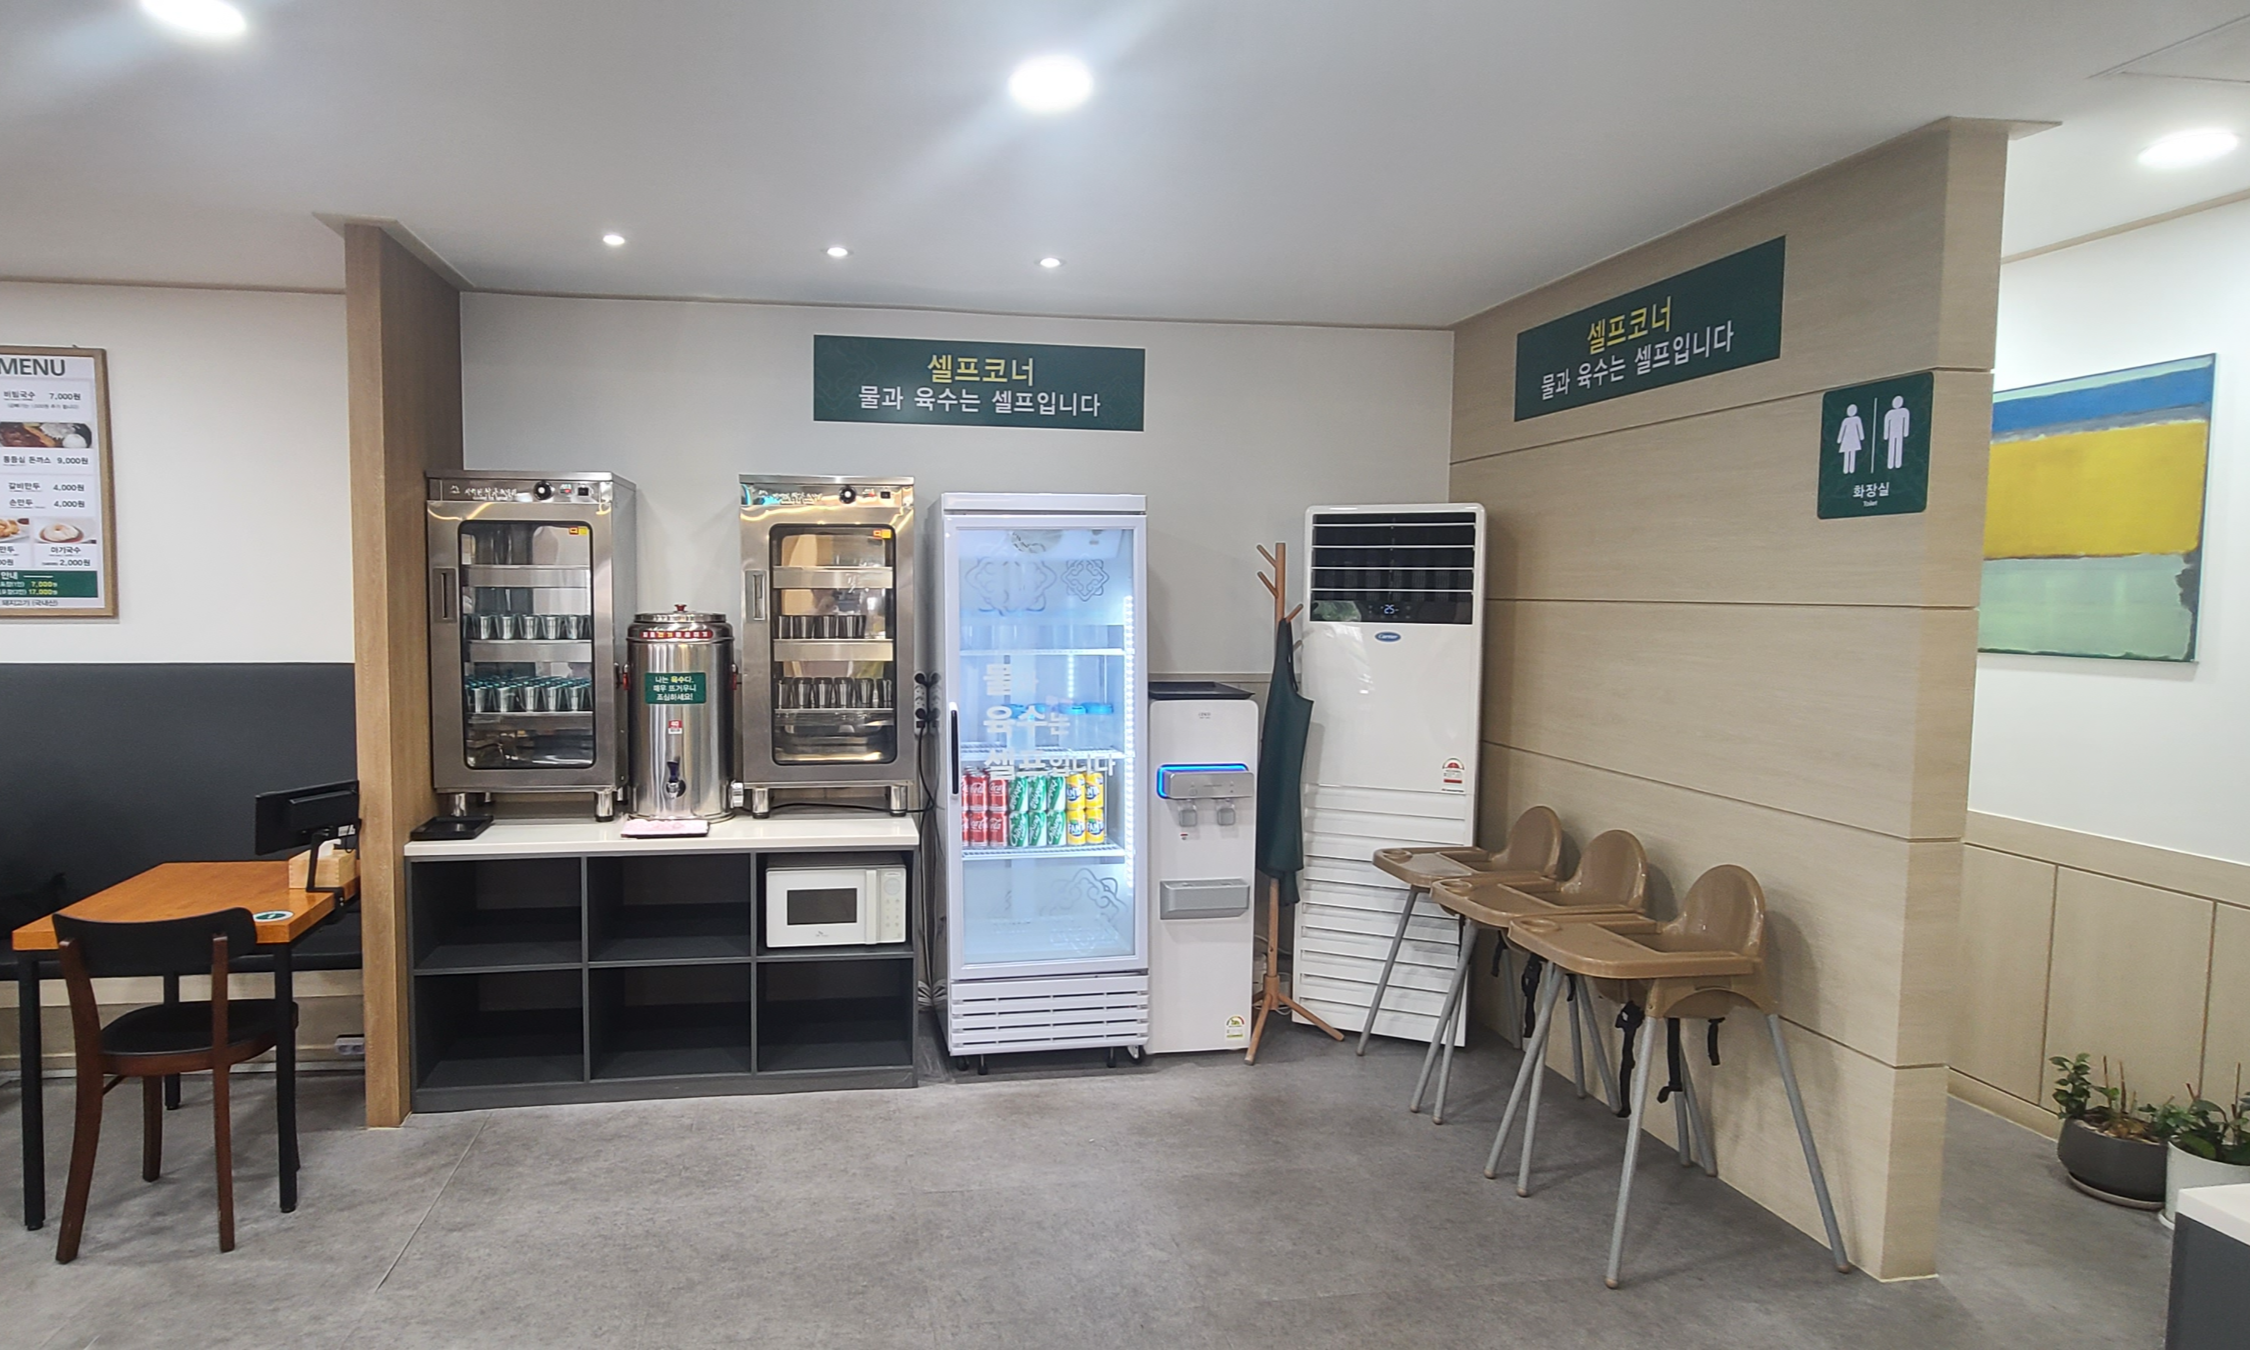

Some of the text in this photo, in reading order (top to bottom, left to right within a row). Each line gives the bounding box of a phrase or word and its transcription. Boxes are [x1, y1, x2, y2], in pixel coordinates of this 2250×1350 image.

[1586, 296, 1672, 355] 셀프코너
[0, 357, 65, 376] MENU
[927, 353, 1035, 387] 셀프코너
[1541, 320, 1734, 401] 물과 육수는 셀프입니다
[858, 385, 1101, 417] 물과 육수는 셀프입니다
[1853, 482, 1890, 498] 화장실
[655, 676, 669, 684] 나는
[656, 693, 694, 701] 조심하세요!
[983, 705, 1070, 739] 육수는
